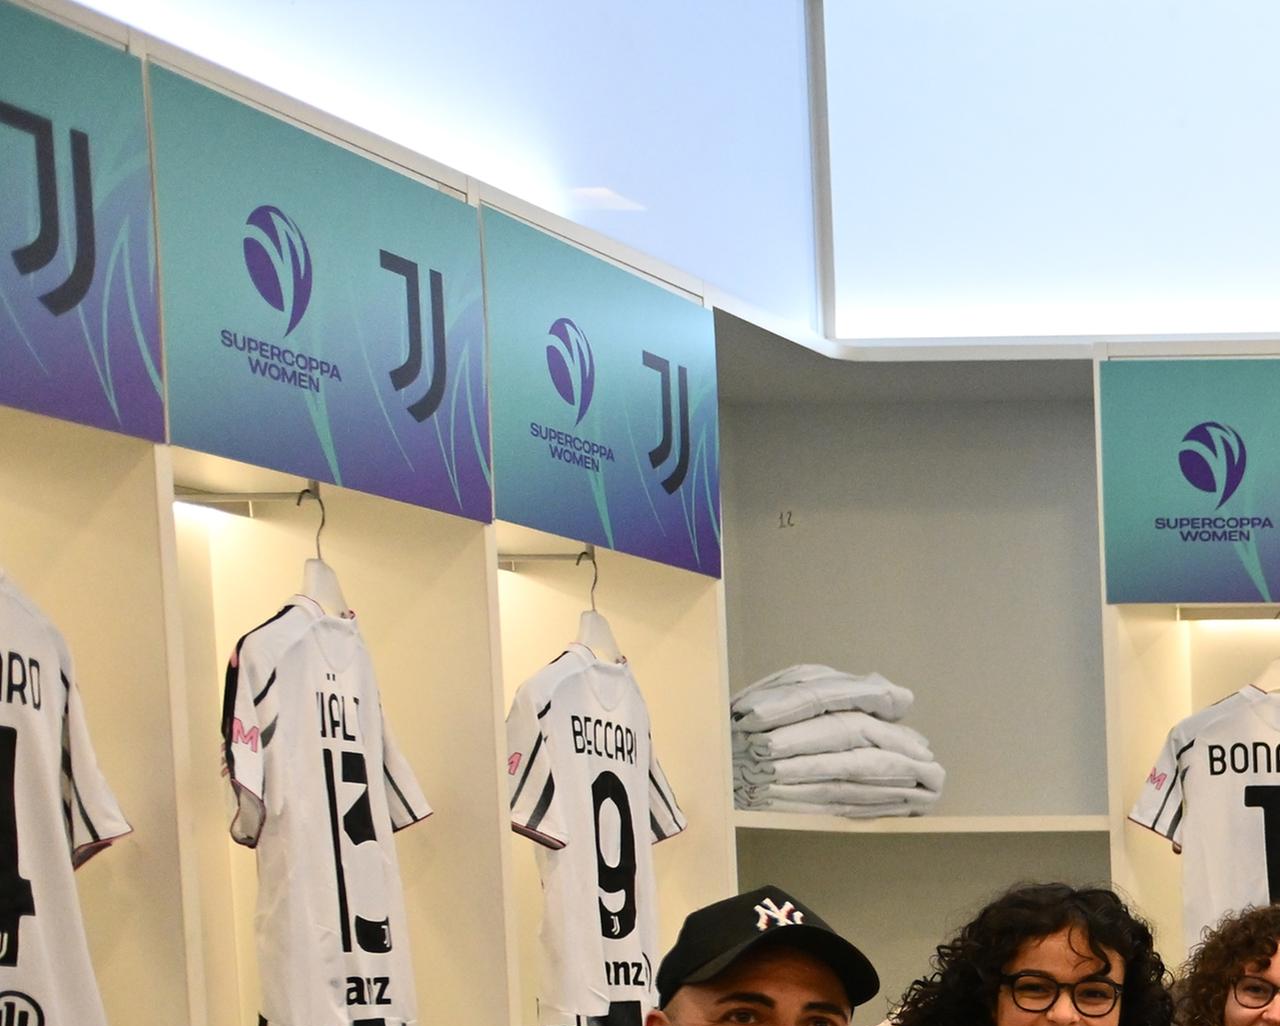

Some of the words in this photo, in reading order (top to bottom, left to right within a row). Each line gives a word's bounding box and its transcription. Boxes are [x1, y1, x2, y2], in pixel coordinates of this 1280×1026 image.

[220, 328, 342, 382] SUPERCOPPA
[248, 355, 321, 394] WOMEN
[530, 421, 615, 463] SUPERCOPPA
[549, 443, 600, 473] WOMEN
[1154, 517, 1274, 531] SUPERCOPPA
[1179, 529, 1251, 543] WOMEN
[571, 714, 637, 766] BECCARI
[591, 770, 636, 940] 9
